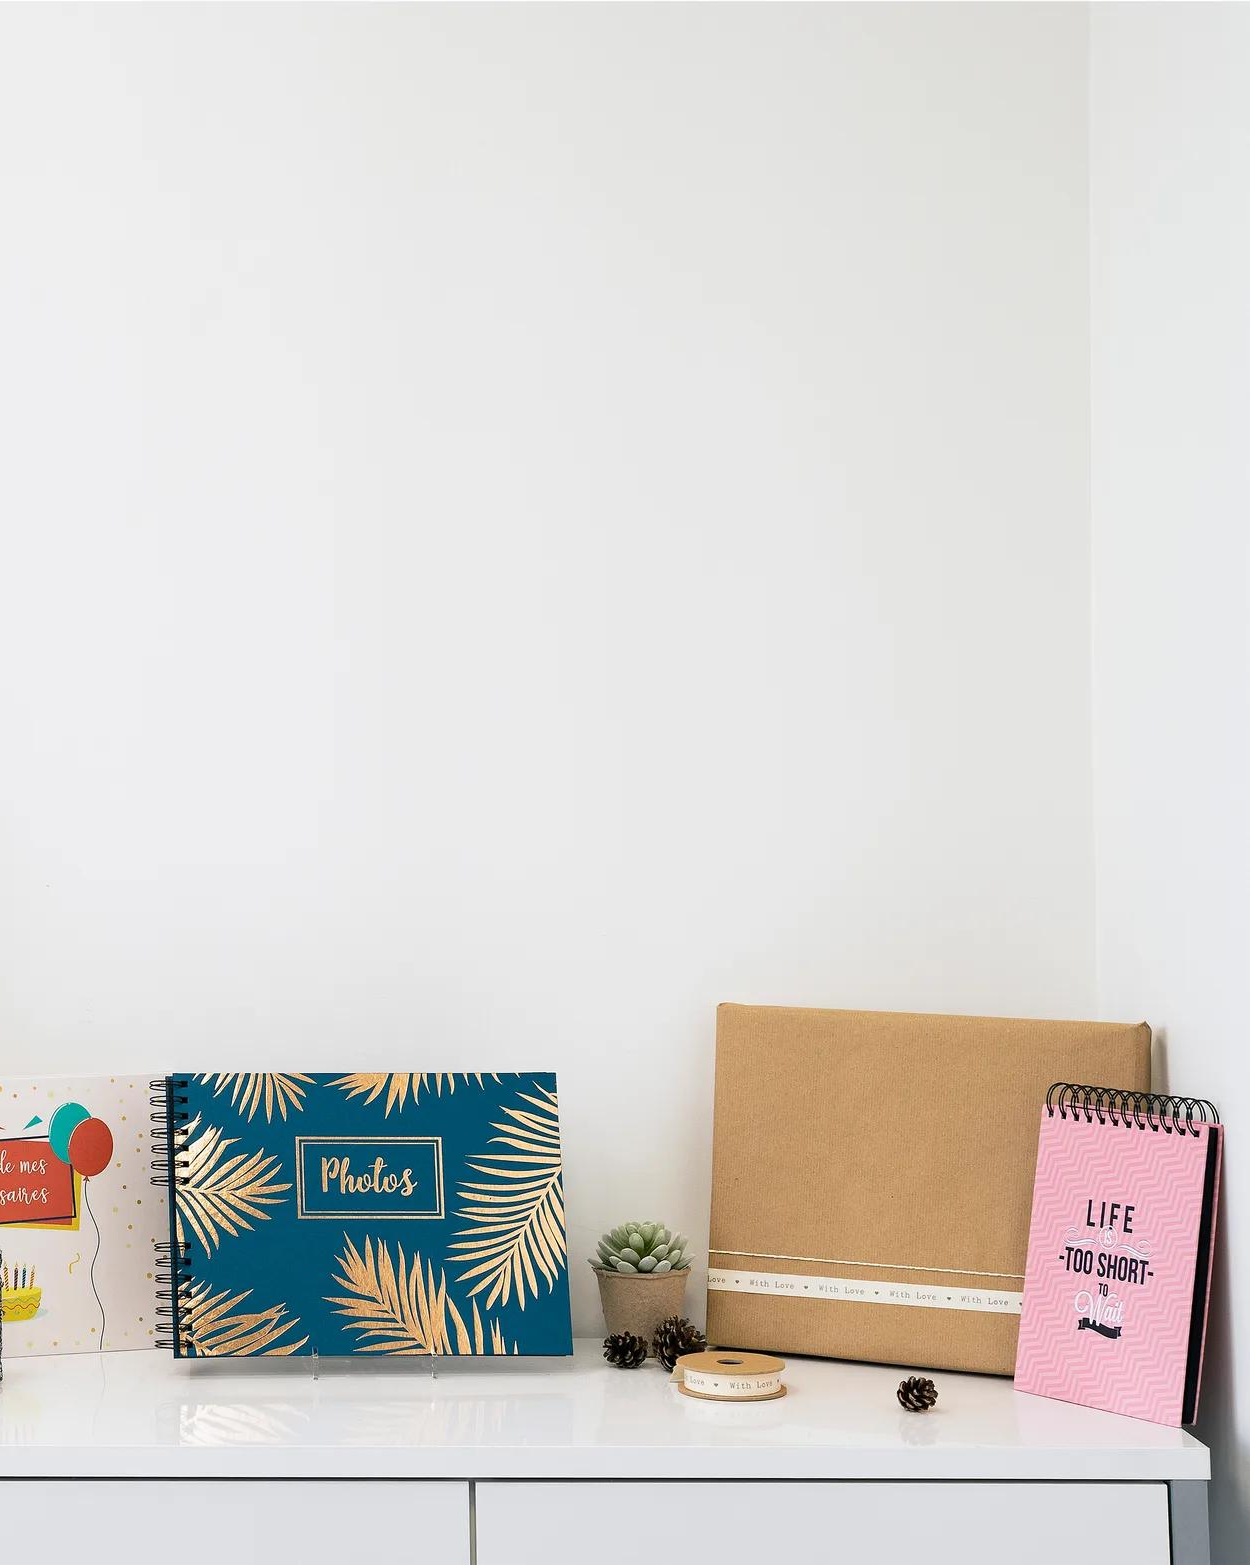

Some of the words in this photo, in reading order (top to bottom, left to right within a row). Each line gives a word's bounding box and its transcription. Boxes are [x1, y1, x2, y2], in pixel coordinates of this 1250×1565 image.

[19, 1158, 48, 1175] mes
[321, 1156, 418, 1197] Photos
[1086, 1199, 1135, 1234] LIFE
[707, 1274, 726, 1284] Love
[749, 1279, 770, 1288] With
[775, 1281, 795, 1290] Love
[818, 1284, 839, 1293] With
[844, 1286, 865, 1296] Love
[889, 1290, 911, 1299] With
[916, 1291, 937, 1301] Love
[961, 1295, 982, 1304] With
[988, 1297, 1009, 1306] Love
[1098, 1282, 1109, 1297] TO
[1074, 1290, 1123, 1326] Wait
[729, 1382, 752, 1390] With
[756, 1380, 773, 1389] Love
